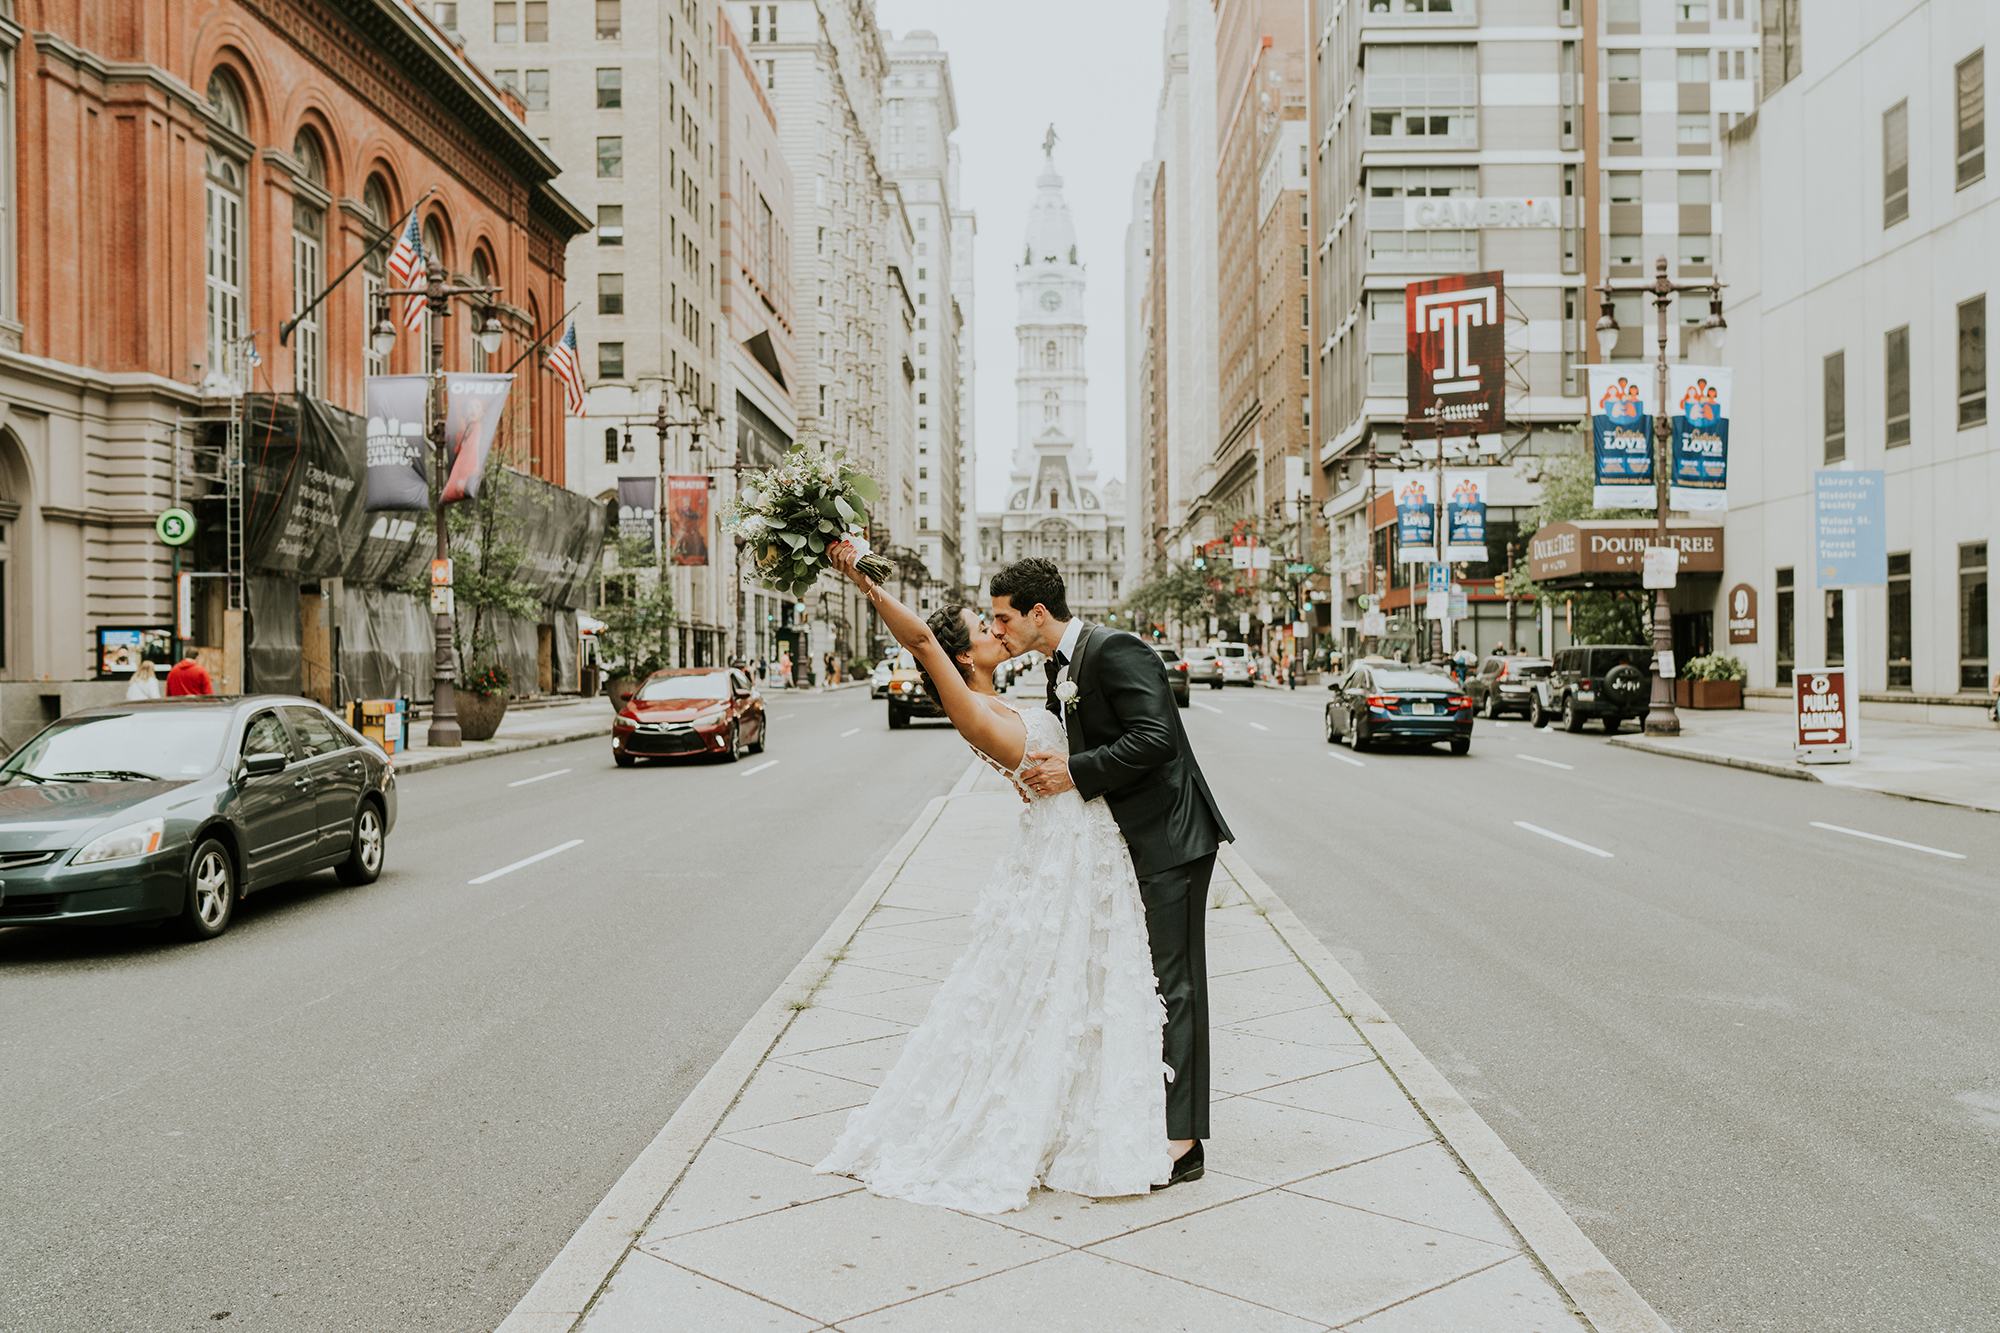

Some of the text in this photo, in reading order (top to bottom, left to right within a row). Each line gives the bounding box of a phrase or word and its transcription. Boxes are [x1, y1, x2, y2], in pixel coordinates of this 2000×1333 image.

[450, 381, 506, 395] OPERA
[366, 436, 409, 449] KIMMEL
[1603, 437, 1647, 450] LOVE
[1682, 439, 1723, 453] LOVE
[366, 446, 421, 458] CULTURAL
[670, 481, 706, 490] THEATER
[1818, 476, 1875, 487] Library Co.
[1818, 491, 1867, 500] Historical
[1820, 501, 1856, 510] Society
[1820, 517, 1854, 526] Walnut
[1821, 526, 1856, 535] Theatre
[1820, 540, 1855, 549] Forrest
[1821, 550, 1857, 558] Theatre
[1617, 556, 1633, 564] BY
[1433, 568, 1447, 583] H
[1817, 681, 1825, 690] P
[1803, 693, 1839, 712] PUBLIC
[1800, 711, 1844, 730] PARKING
